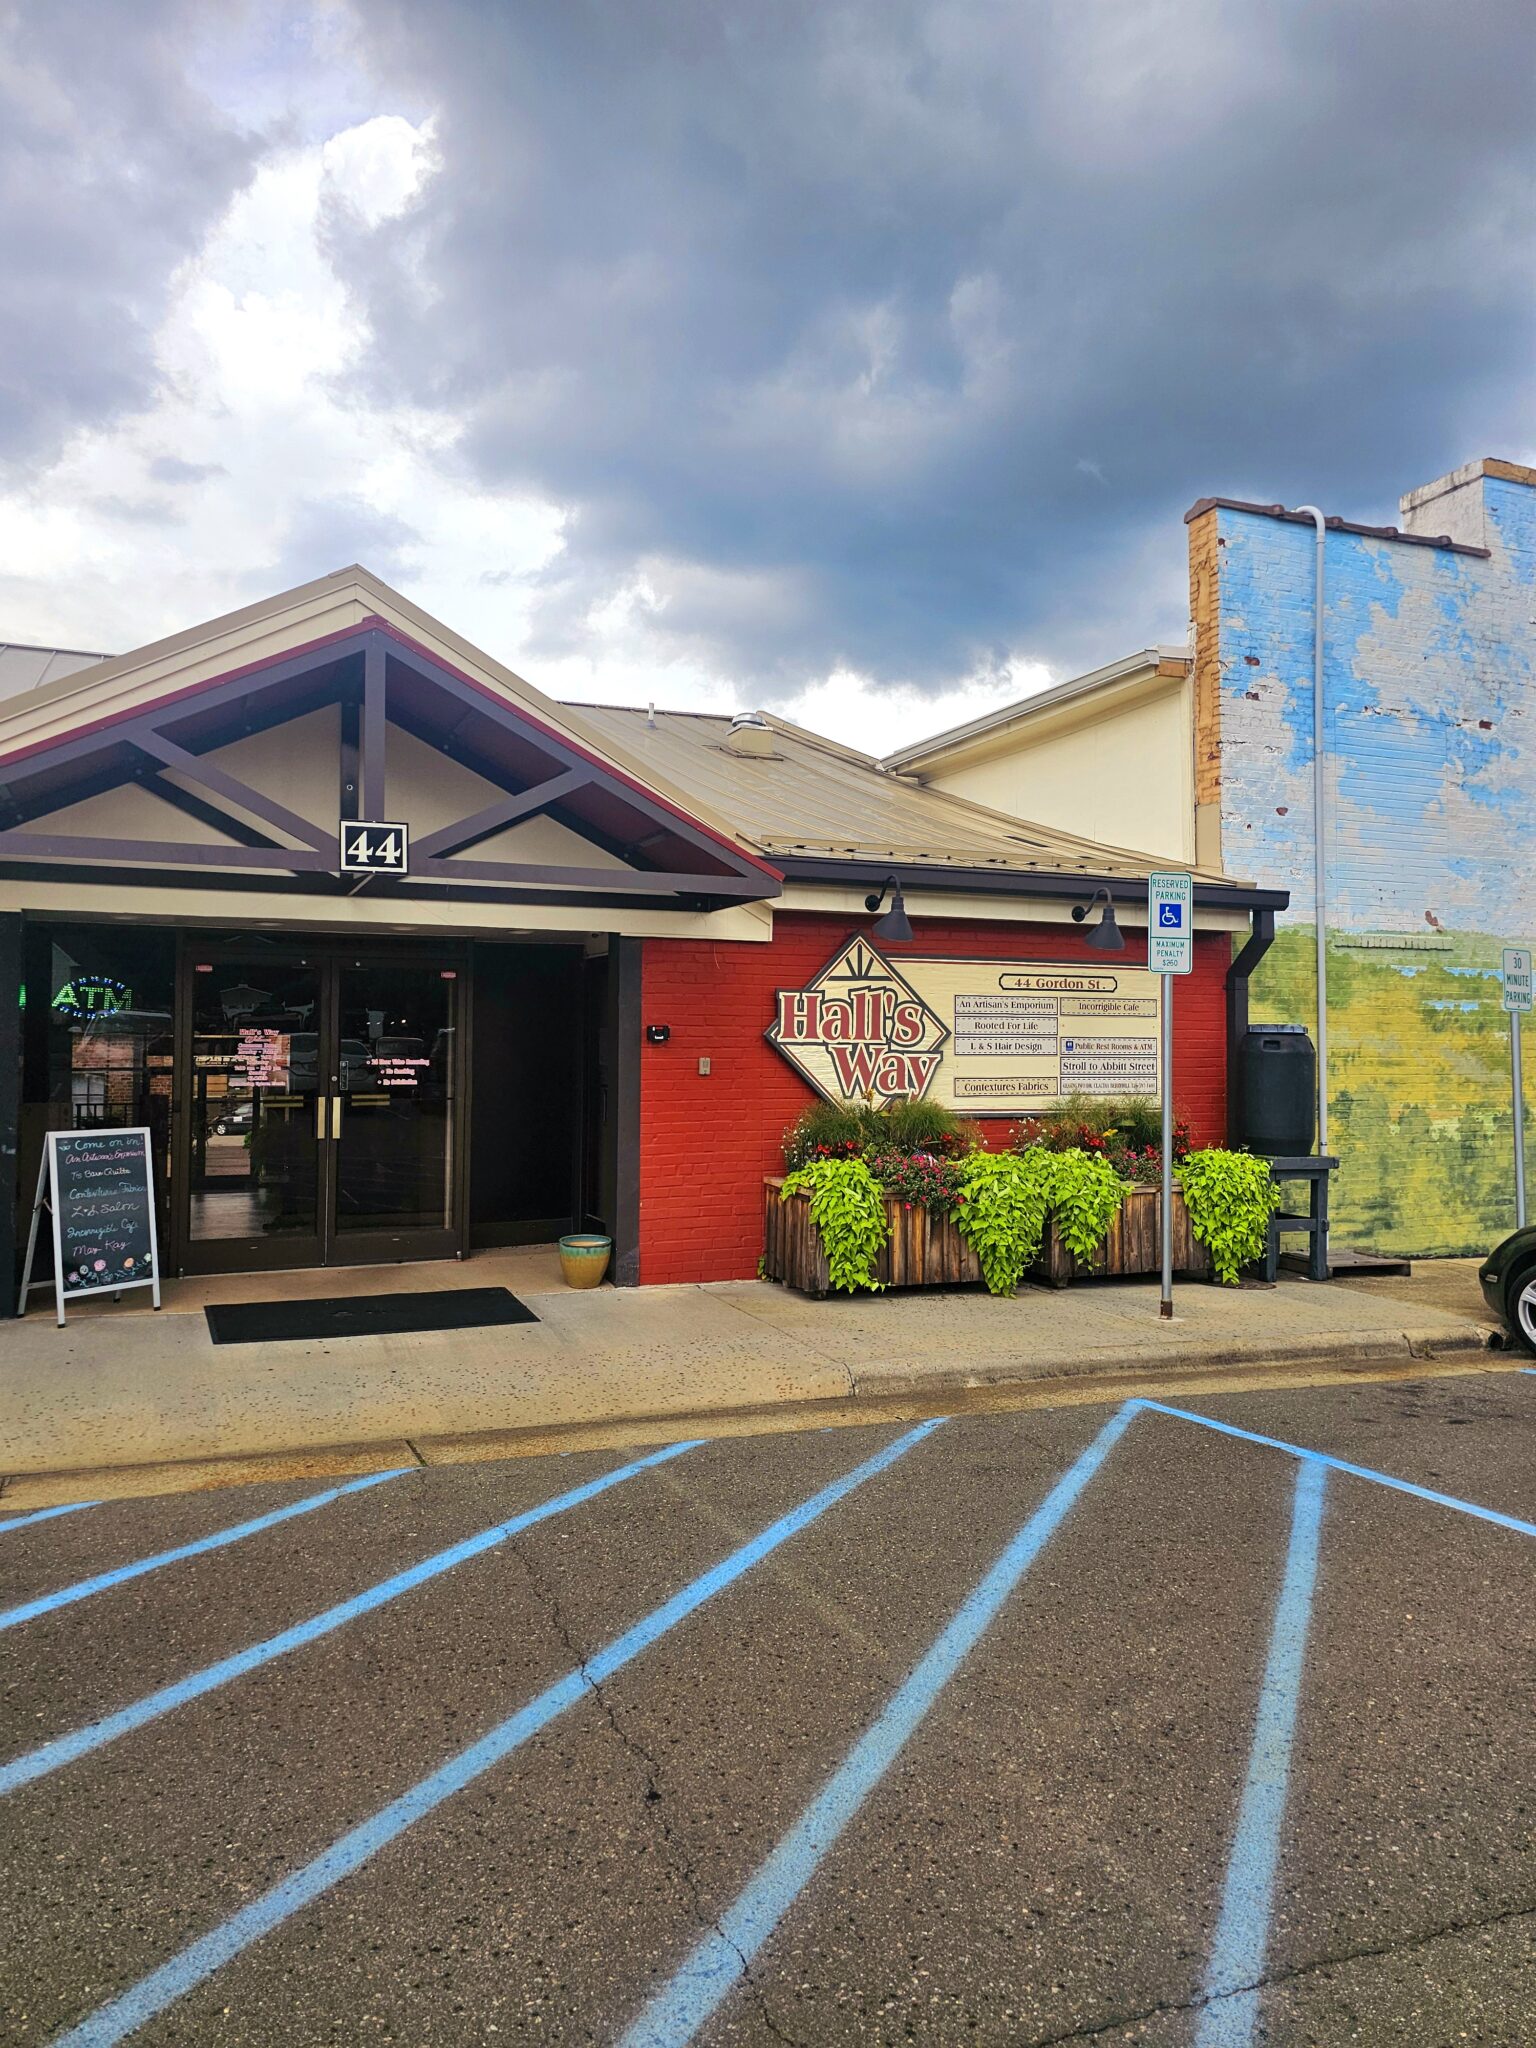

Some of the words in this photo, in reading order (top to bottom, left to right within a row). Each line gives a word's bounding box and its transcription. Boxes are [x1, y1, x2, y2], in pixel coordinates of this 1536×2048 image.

[347, 830, 401, 864] 44
[1153, 879, 1189, 888] RESERVED
[1156, 891, 1186, 901] PARKING
[1513, 957, 1522, 969] 30
[1014, 978, 1031, 988] 44
[1036, 978, 1083, 989] Gordon
[1506, 973, 1529, 987] MINUTE
[52, 983, 133, 1010] ATM
[1505, 990, 1531, 1004] PARKING
[973, 1000, 1009, 1008] Artisan's
[1011, 1001, 1054, 1010] Emporium
[1079, 1002, 1121, 1012] Incorrigible
[778, 990, 925, 1046] Hall's
[974, 1021, 1005, 1030] Rooted
[1007, 1022, 1021, 1030] For
[1023, 1022, 1039, 1030] Life
[970, 1042, 976, 1050] L
[978, 1042, 984, 1050] &
[986, 1042, 992, 1050] S
[995, 1042, 1012, 1050] Hair
[1014, 1042, 1042, 1052] Design
[1075, 1042, 1094, 1050] Public
[1062, 1061, 1087, 1071] Stroll
[1089, 1062, 1097, 1070] to
[1100, 1062, 1127, 1071] Abbitt
[1129, 1062, 1155, 1071] Street
[829, 1045, 940, 1101] Way
[964, 1083, 1016, 1092] Contextures
[1018, 1082, 1049, 1091] Fabrics
[75, 1139, 105, 1151] Come
[109, 1139, 124, 1147] on
[126, 1135, 144, 1146] in!
[100, 1202, 140, 1214] Salon
[104, 1239, 132, 1252] Kay
